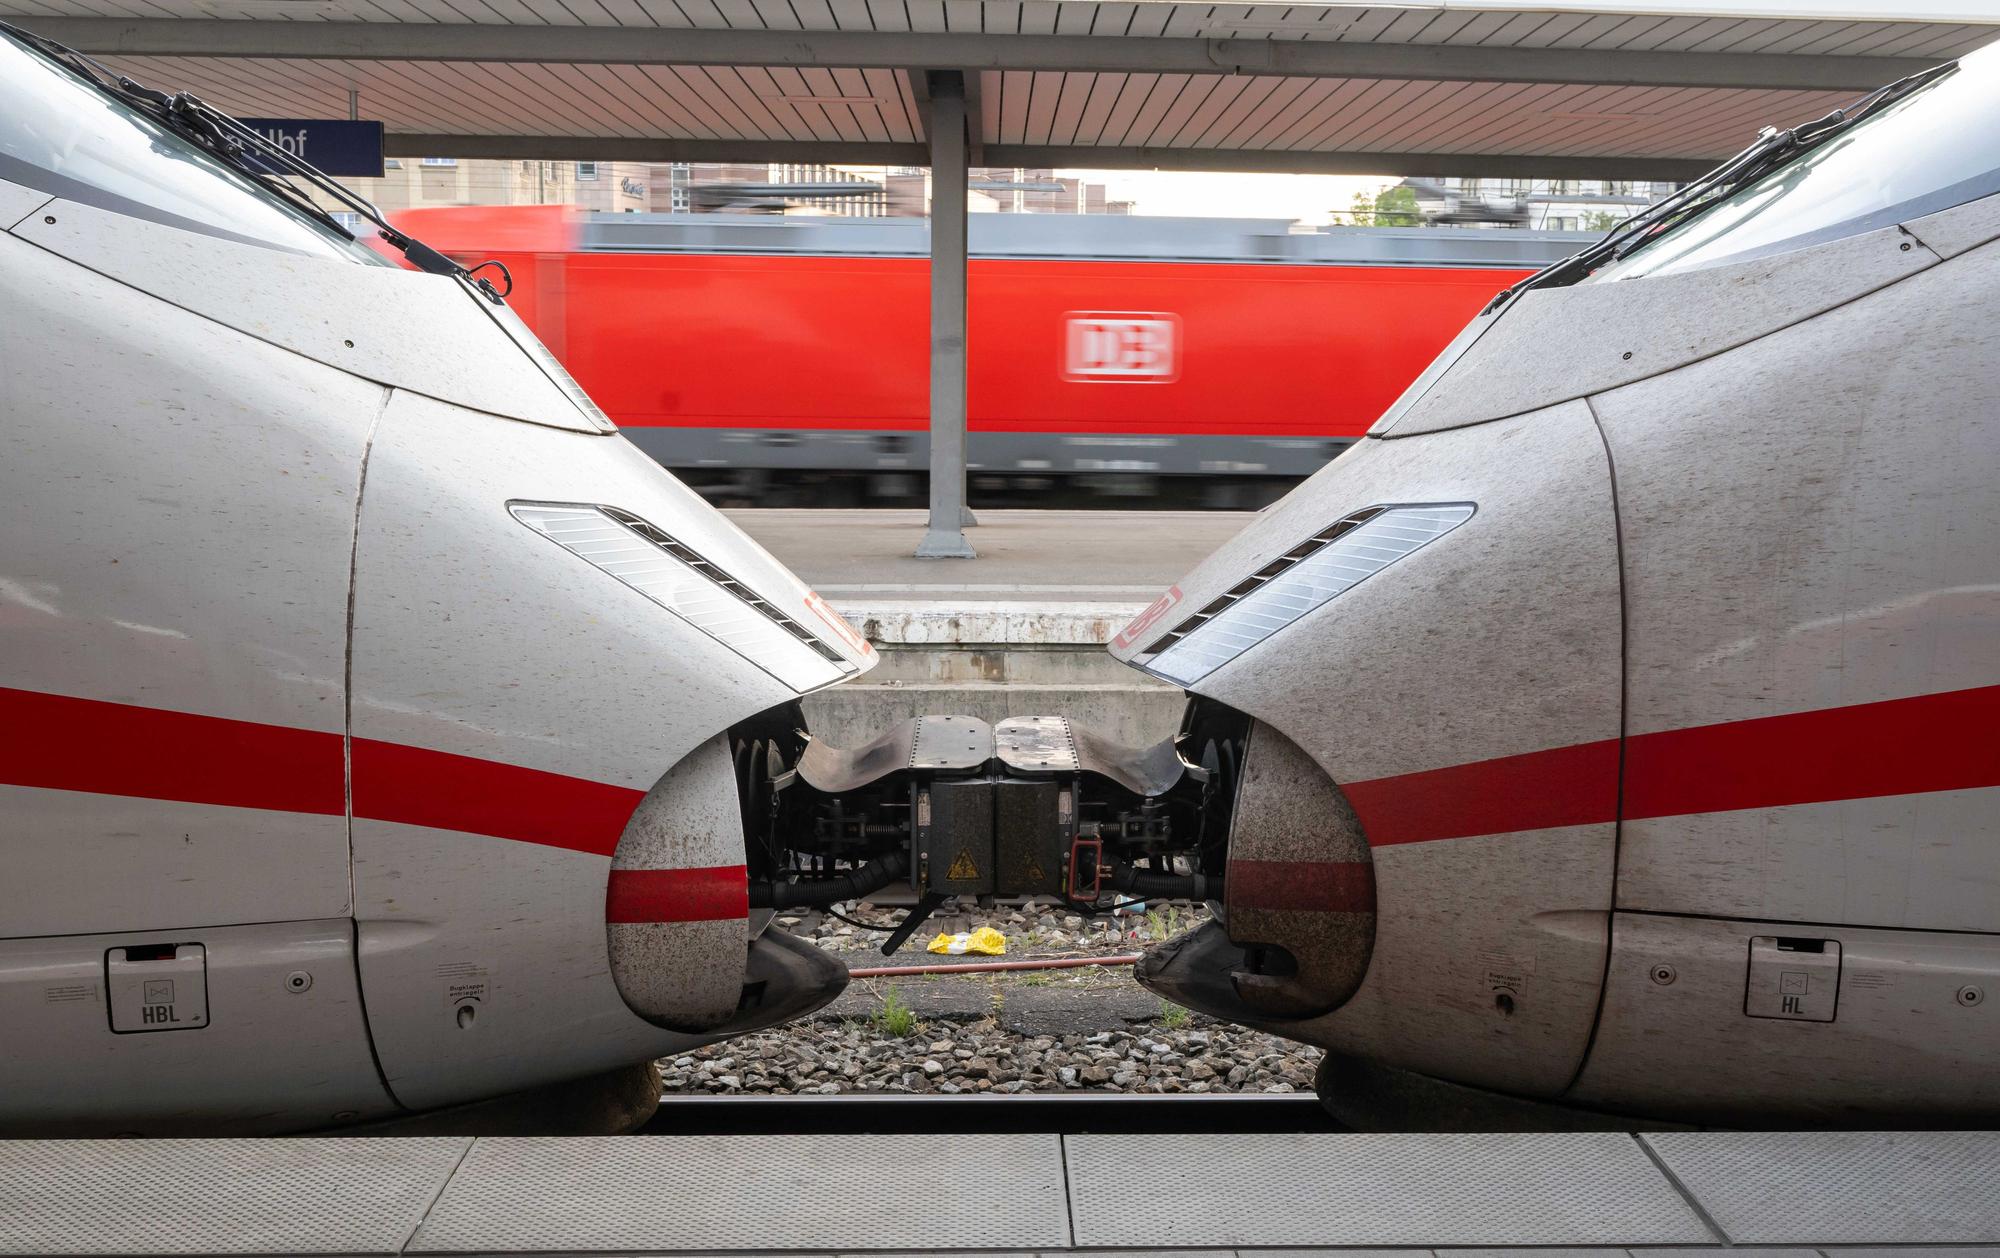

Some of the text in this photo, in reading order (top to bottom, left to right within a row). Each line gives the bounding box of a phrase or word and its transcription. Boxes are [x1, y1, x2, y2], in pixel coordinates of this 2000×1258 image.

[1066, 319, 1173, 374] DB
[142, 1005, 180, 1024] HBL
[1781, 996, 1804, 1014] HL
